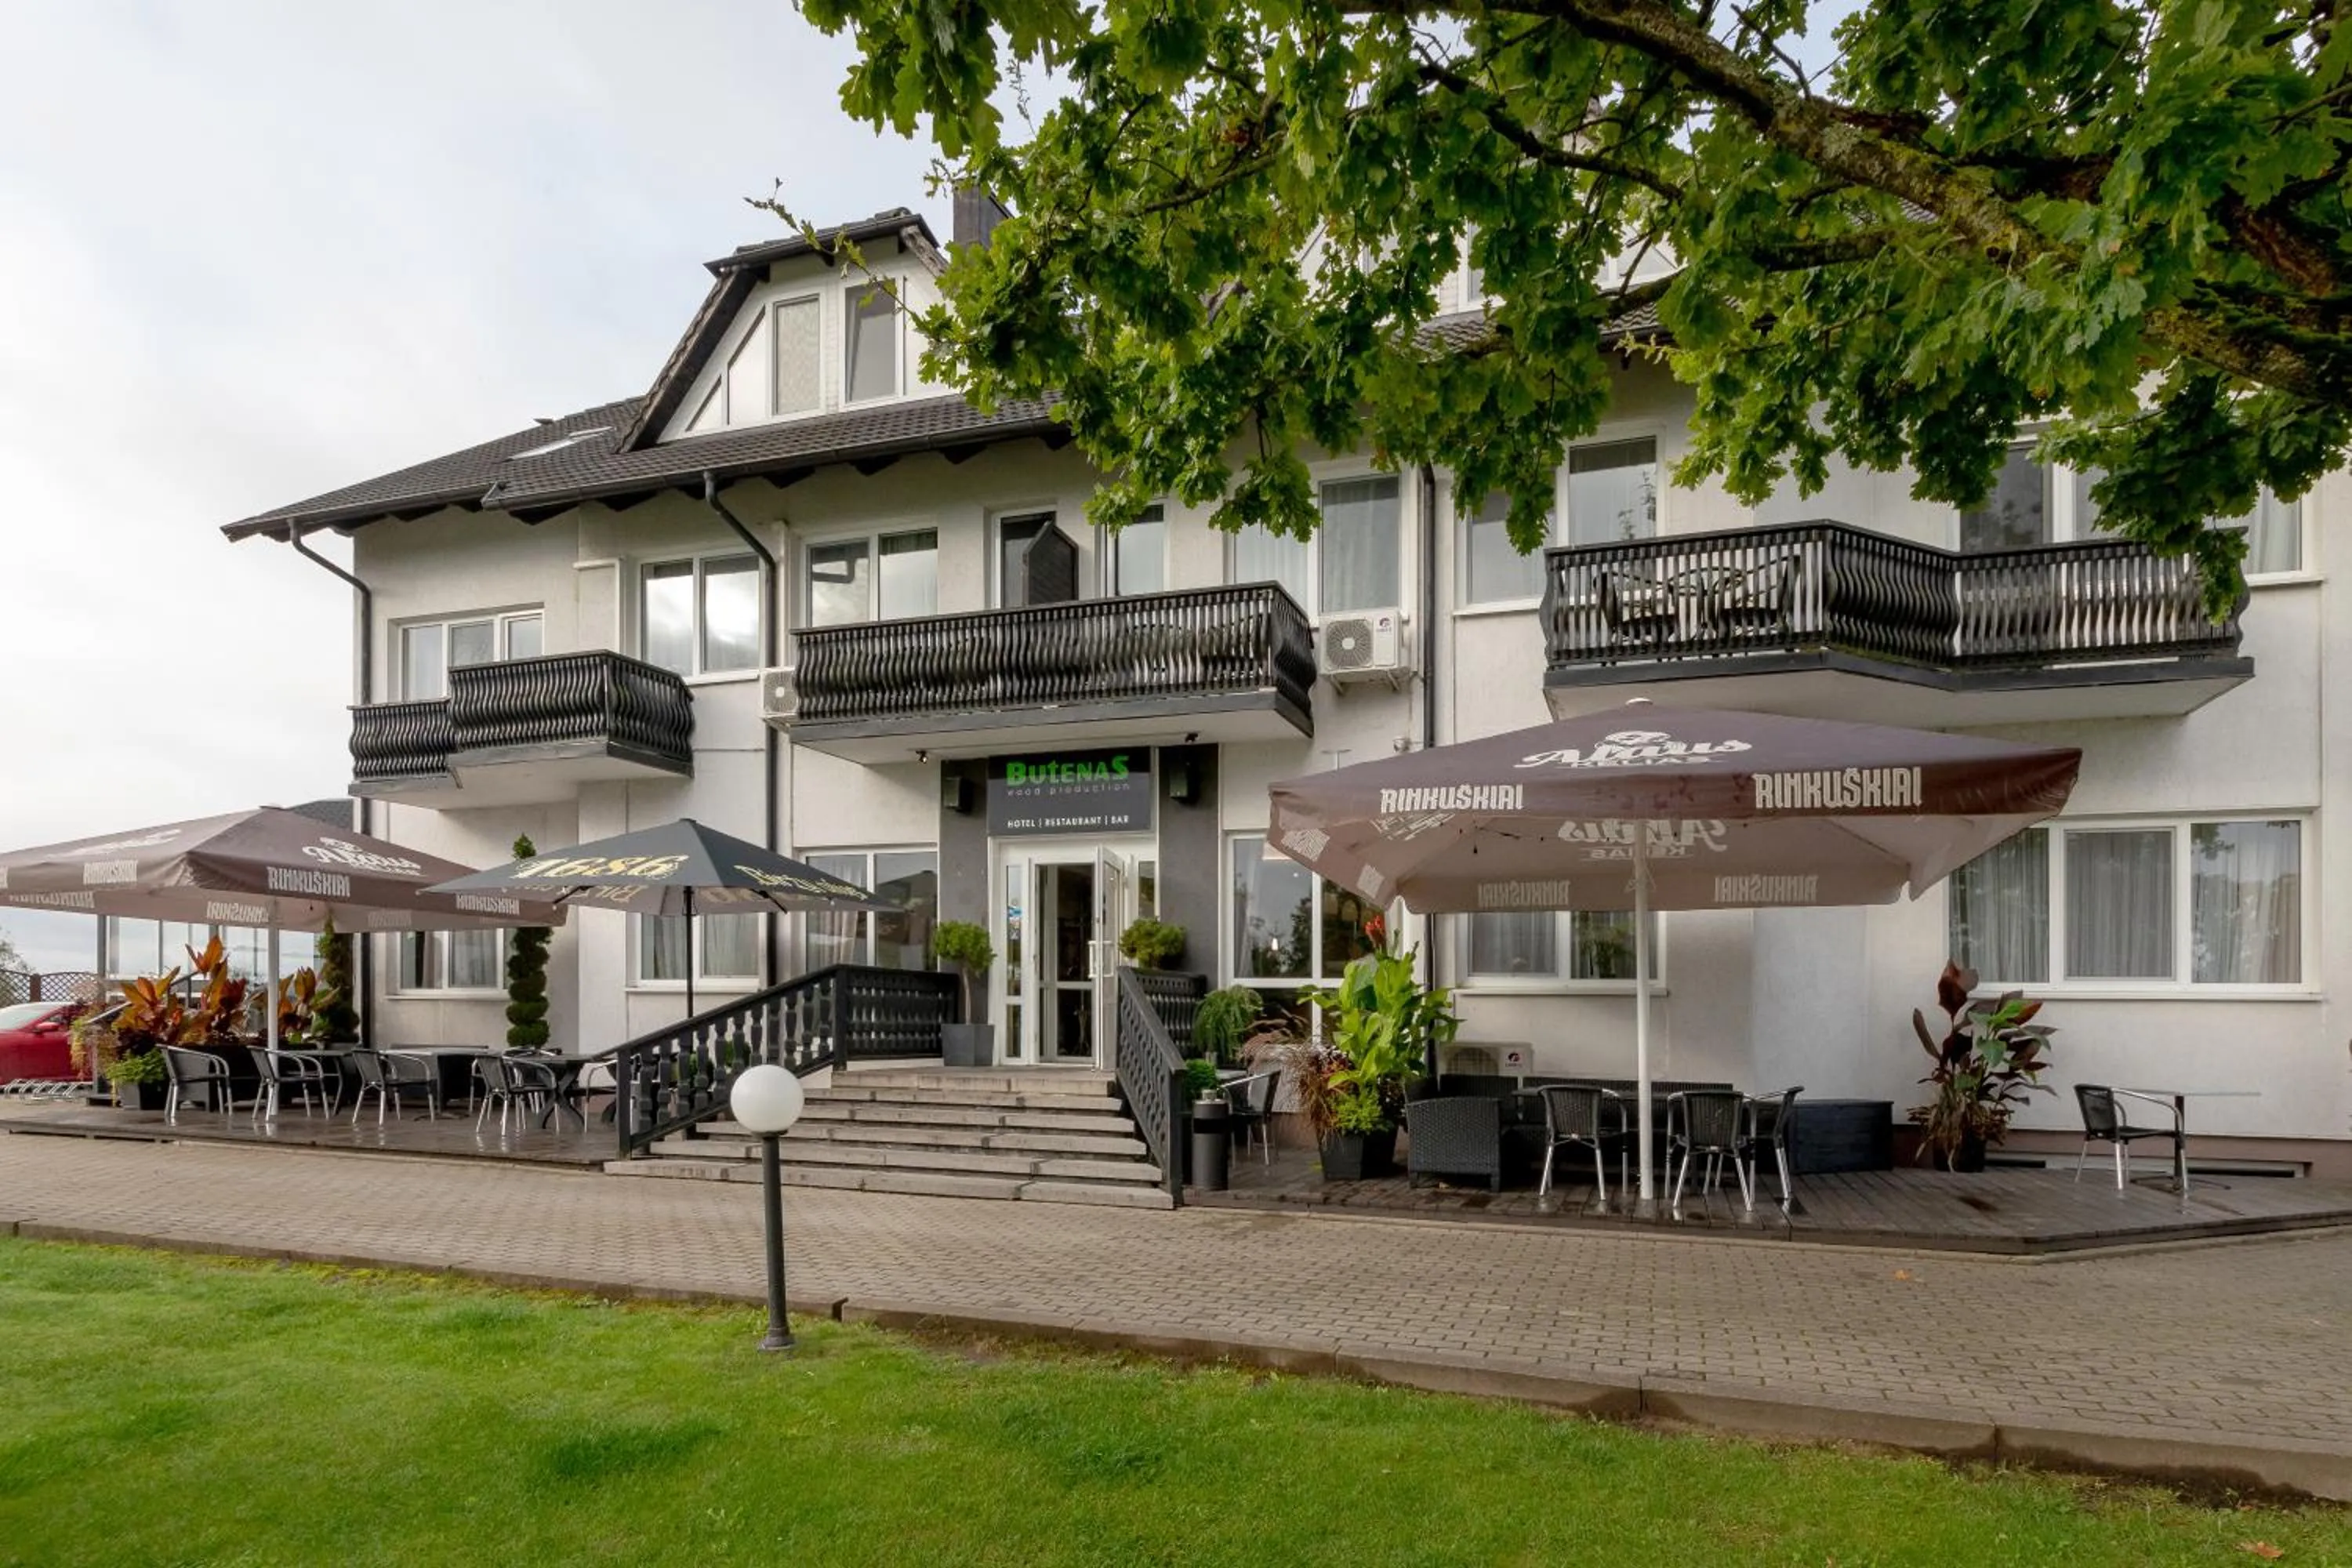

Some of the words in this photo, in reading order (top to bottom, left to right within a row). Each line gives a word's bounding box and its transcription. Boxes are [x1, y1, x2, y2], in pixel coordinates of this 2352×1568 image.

[1050, 783, 1130, 795] production
[1752, 767, 1922, 808] RINKUŠKIAI
[1007, 819, 1036, 828] HOTEL
[1045, 816, 1102, 827] RESTAURANT
